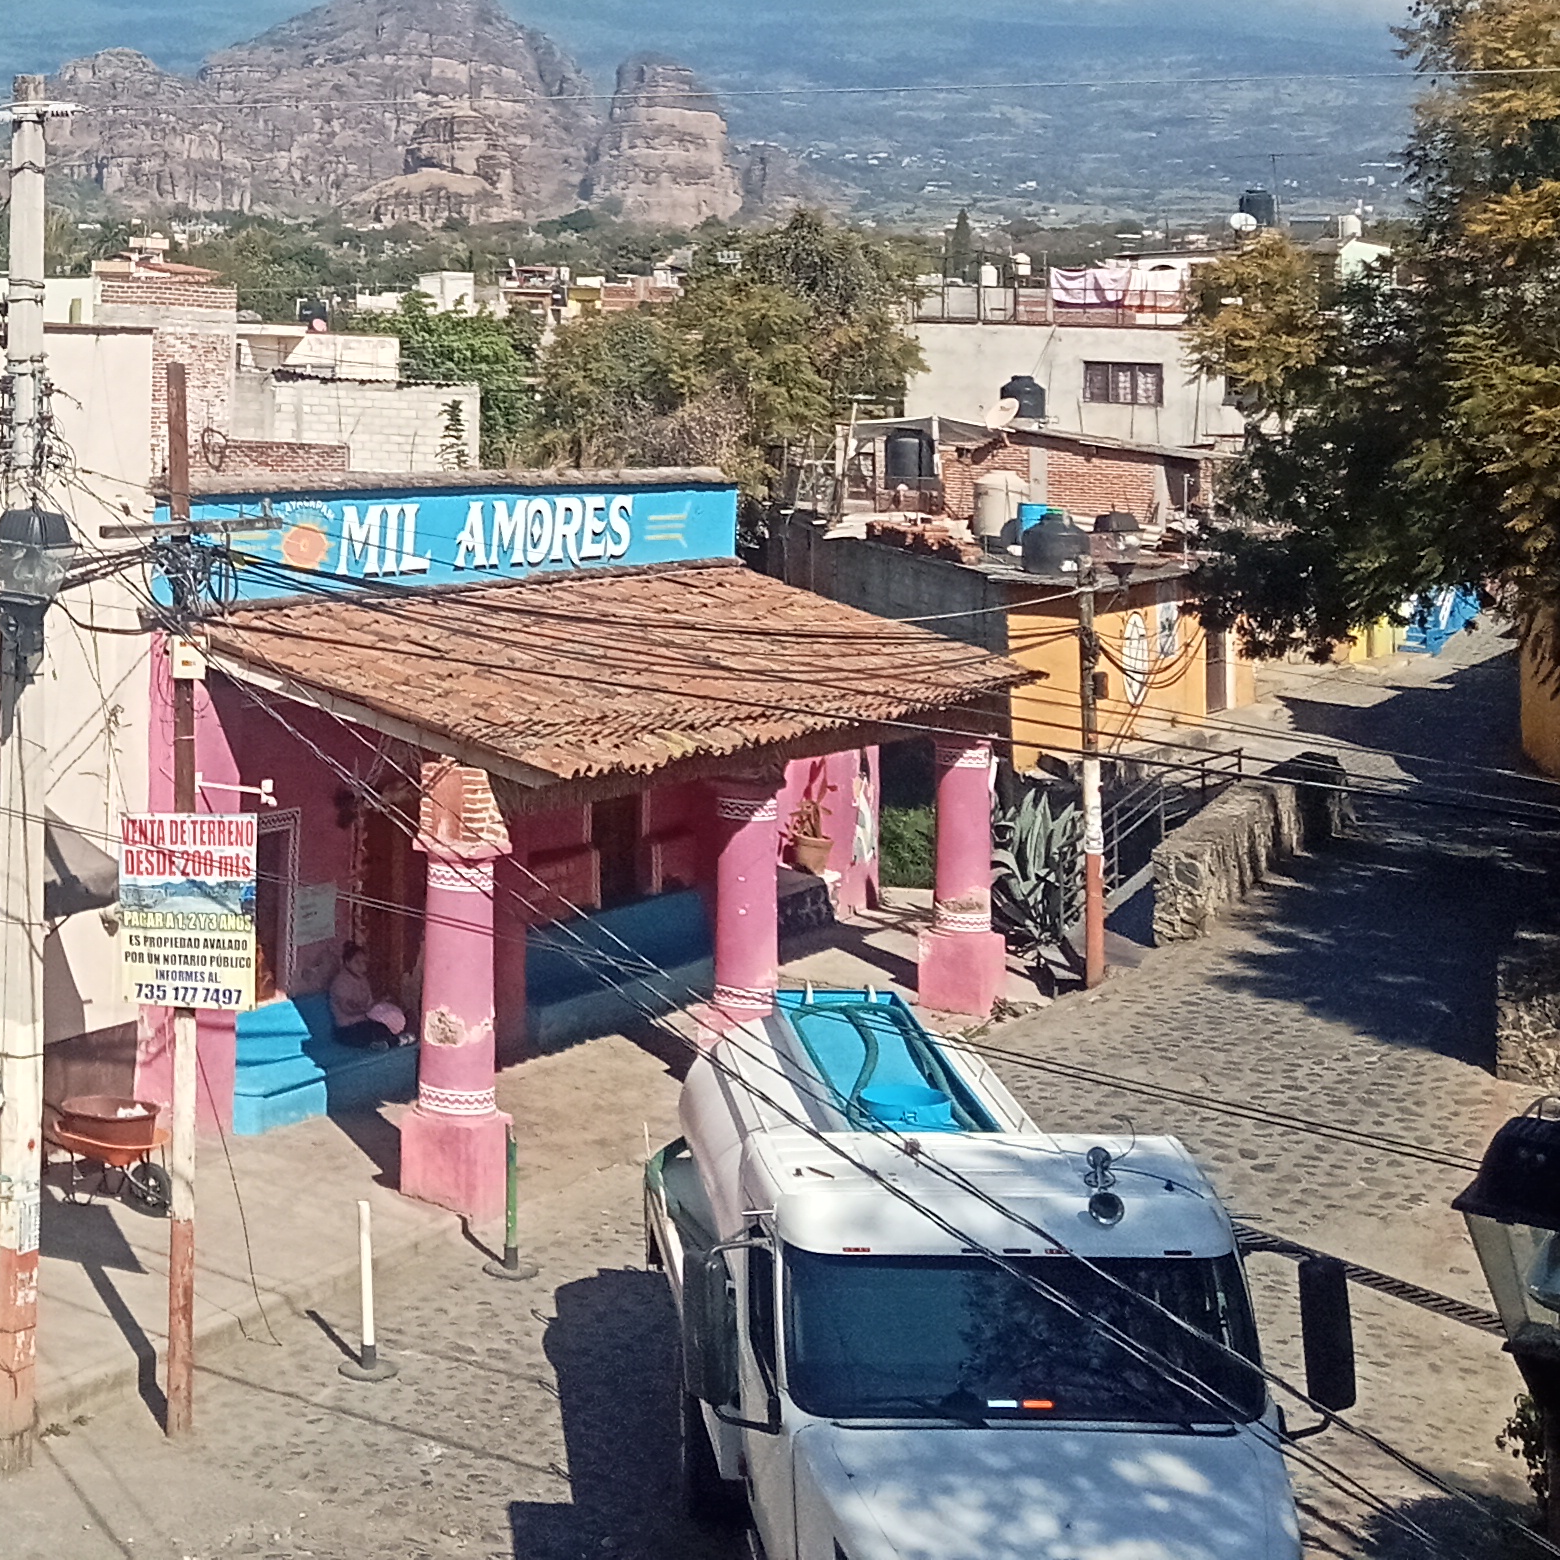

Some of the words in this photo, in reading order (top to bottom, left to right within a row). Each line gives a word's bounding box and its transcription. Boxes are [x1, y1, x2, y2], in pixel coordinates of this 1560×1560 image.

[334, 503, 431, 578] MIL
[453, 495, 633, 571] AMORES
[122, 819, 165, 846] VENTA
[170, 820, 187, 846] DE
[190, 820, 254, 847] TERRENO
[125, 849, 176, 877] DESDE
[180, 850, 214, 877] 200
[218, 853, 251, 877] mts
[123, 911, 164, 928] PAGAR
[165, 912, 175, 929] A
[187, 912, 198, 930] 2
[198, 913, 208, 930] Y
[208, 913, 218, 930] 3
[129, 934, 141, 947] ES
[143, 936, 200, 949] PROPIEDAD
[203, 938, 248, 951] AVALADO
[124, 951, 145, 963] POR
[147, 953, 160, 965] UN
[162, 954, 207, 967] NOTARIO
[209, 954, 251, 969] PÚBLICO
[155, 968, 205, 983] INFORMES
[134, 983, 167, 1001] 735
[172, 986, 198, 1003] 177
[202, 987, 242, 1005] 7497
